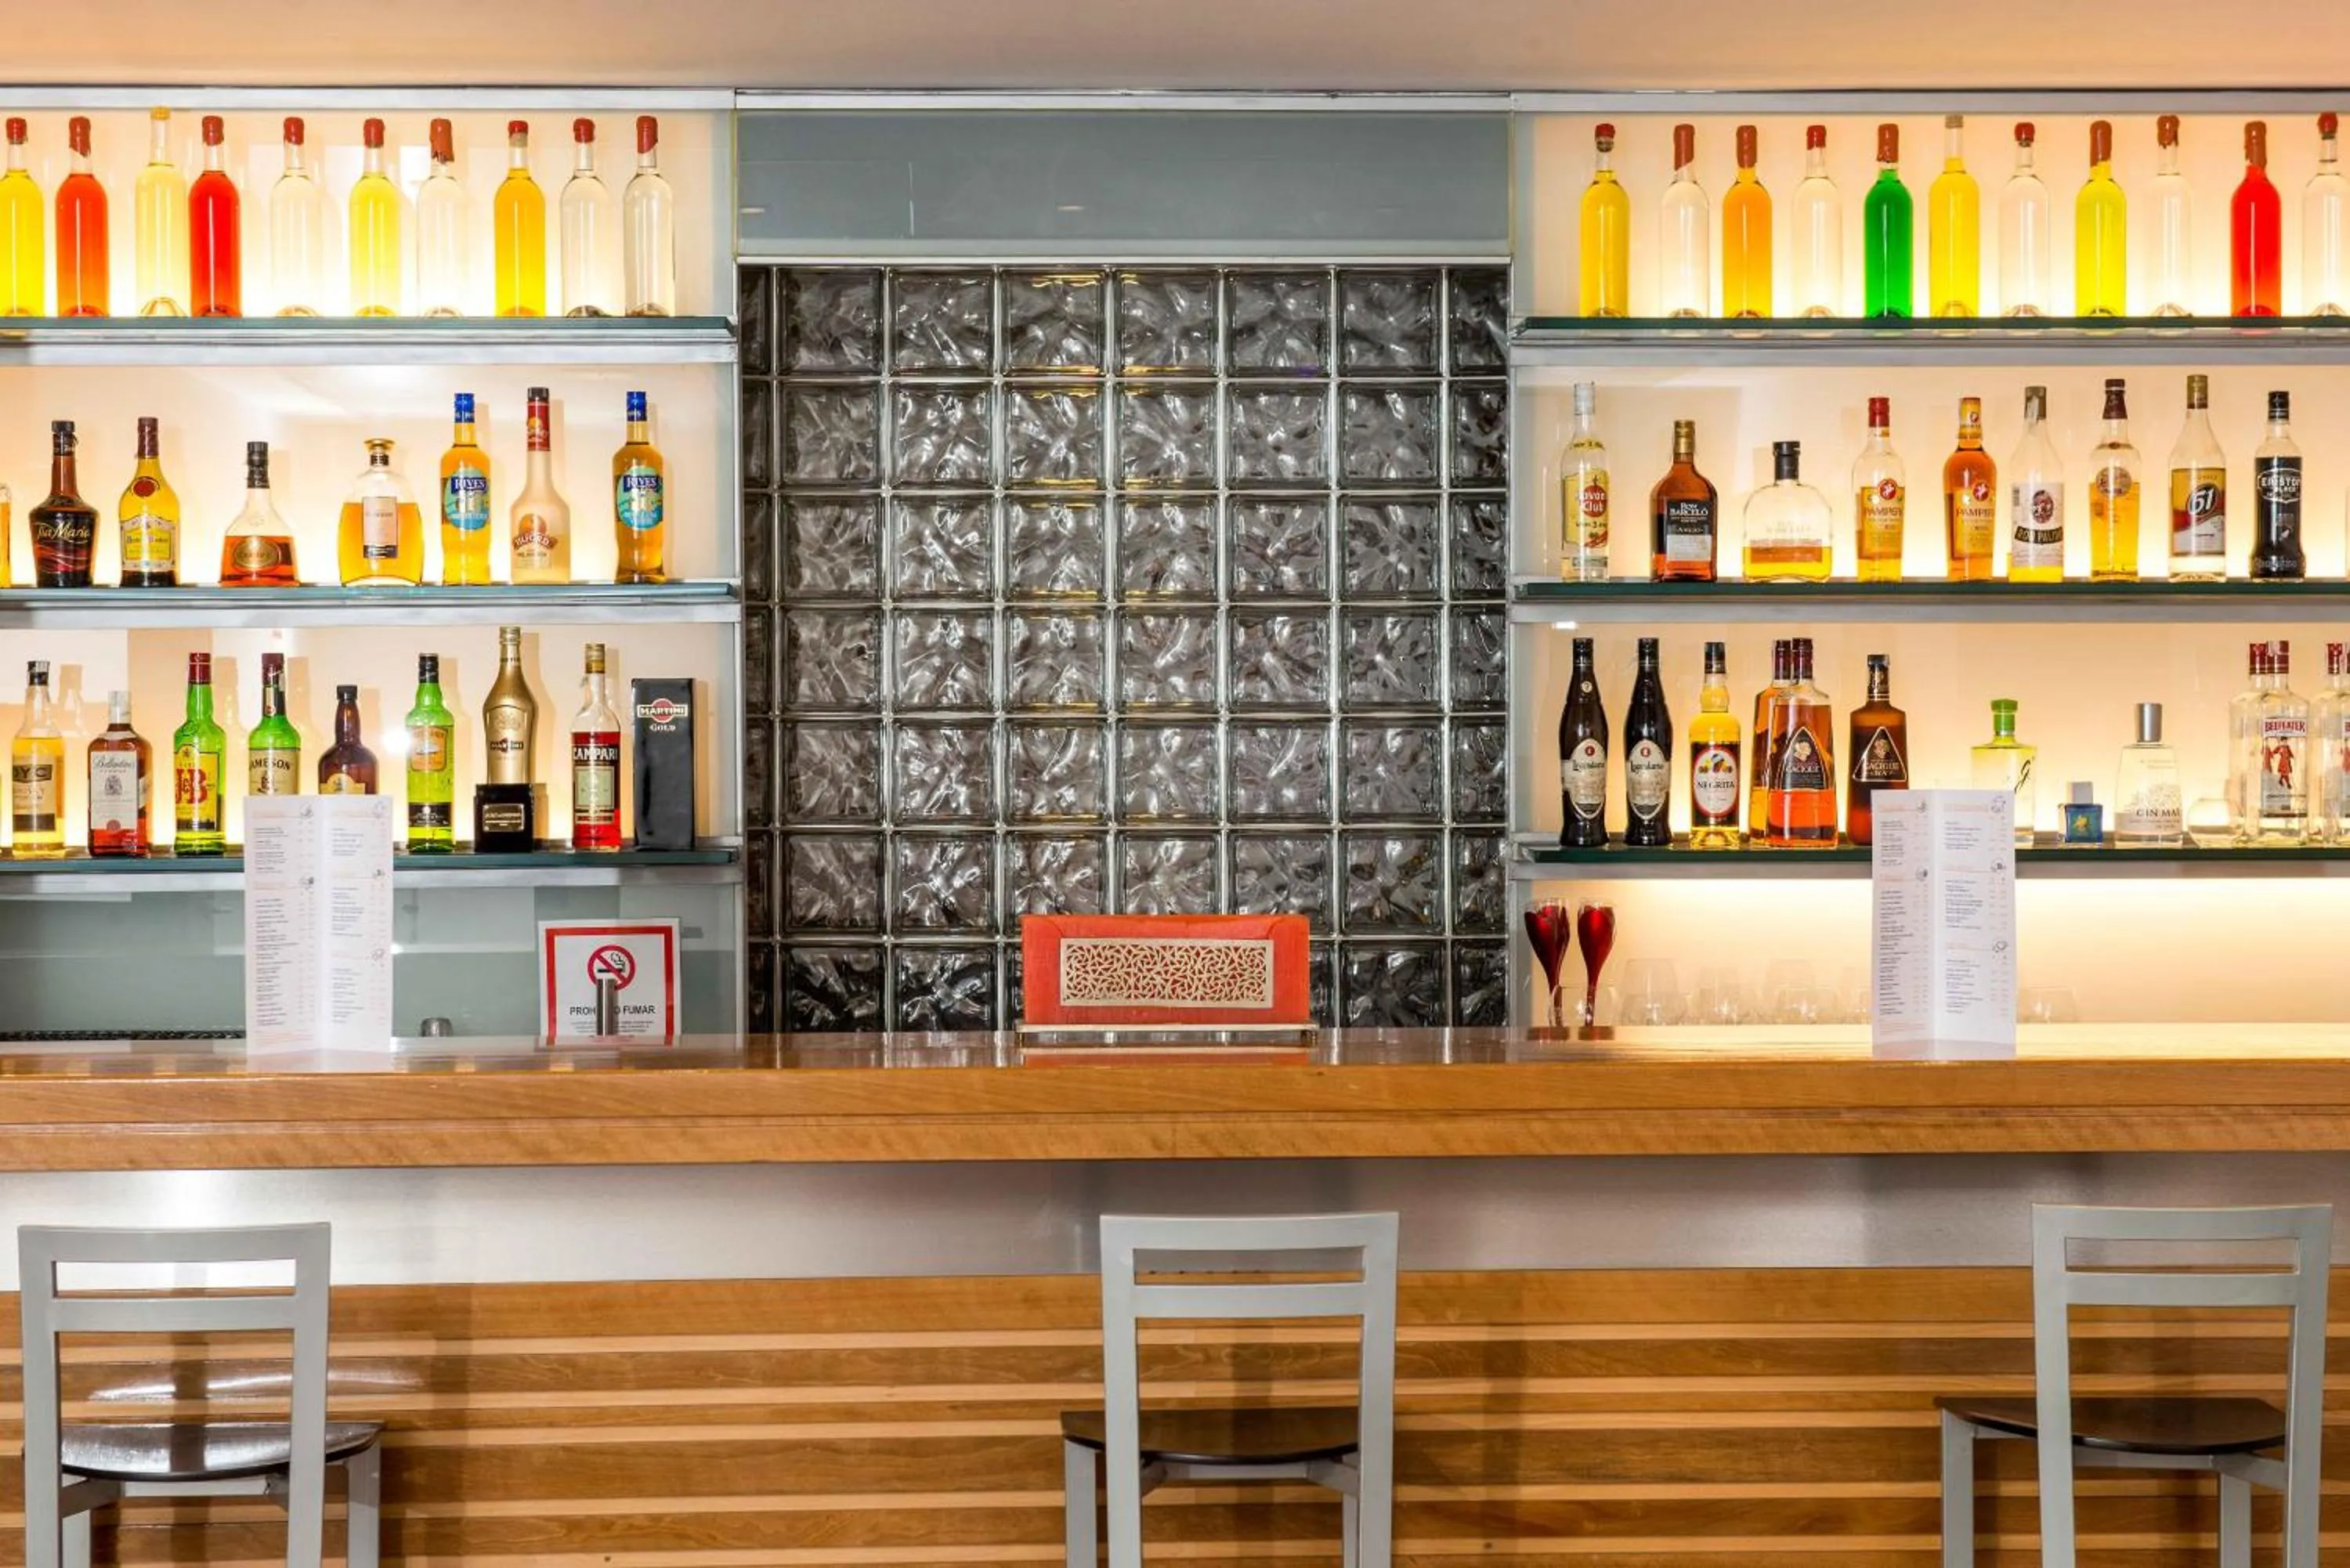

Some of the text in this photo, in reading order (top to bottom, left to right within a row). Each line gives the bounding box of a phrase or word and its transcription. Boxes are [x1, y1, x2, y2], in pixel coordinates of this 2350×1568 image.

[455, 479, 485, 490] RIVES
[627, 477, 656, 487] RIVES
[2261, 476, 2301, 486] ERISTO
[1863, 507, 1904, 516] PAMPER
[1957, 508, 1991, 518] PAMPE
[2265, 721, 2305, 732] BEEFEATER
[492, 741, 522, 750] MARINI
[573, 747, 617, 761] CAMPARI
[569, 1005, 656, 1016] PROHO FUMAR
